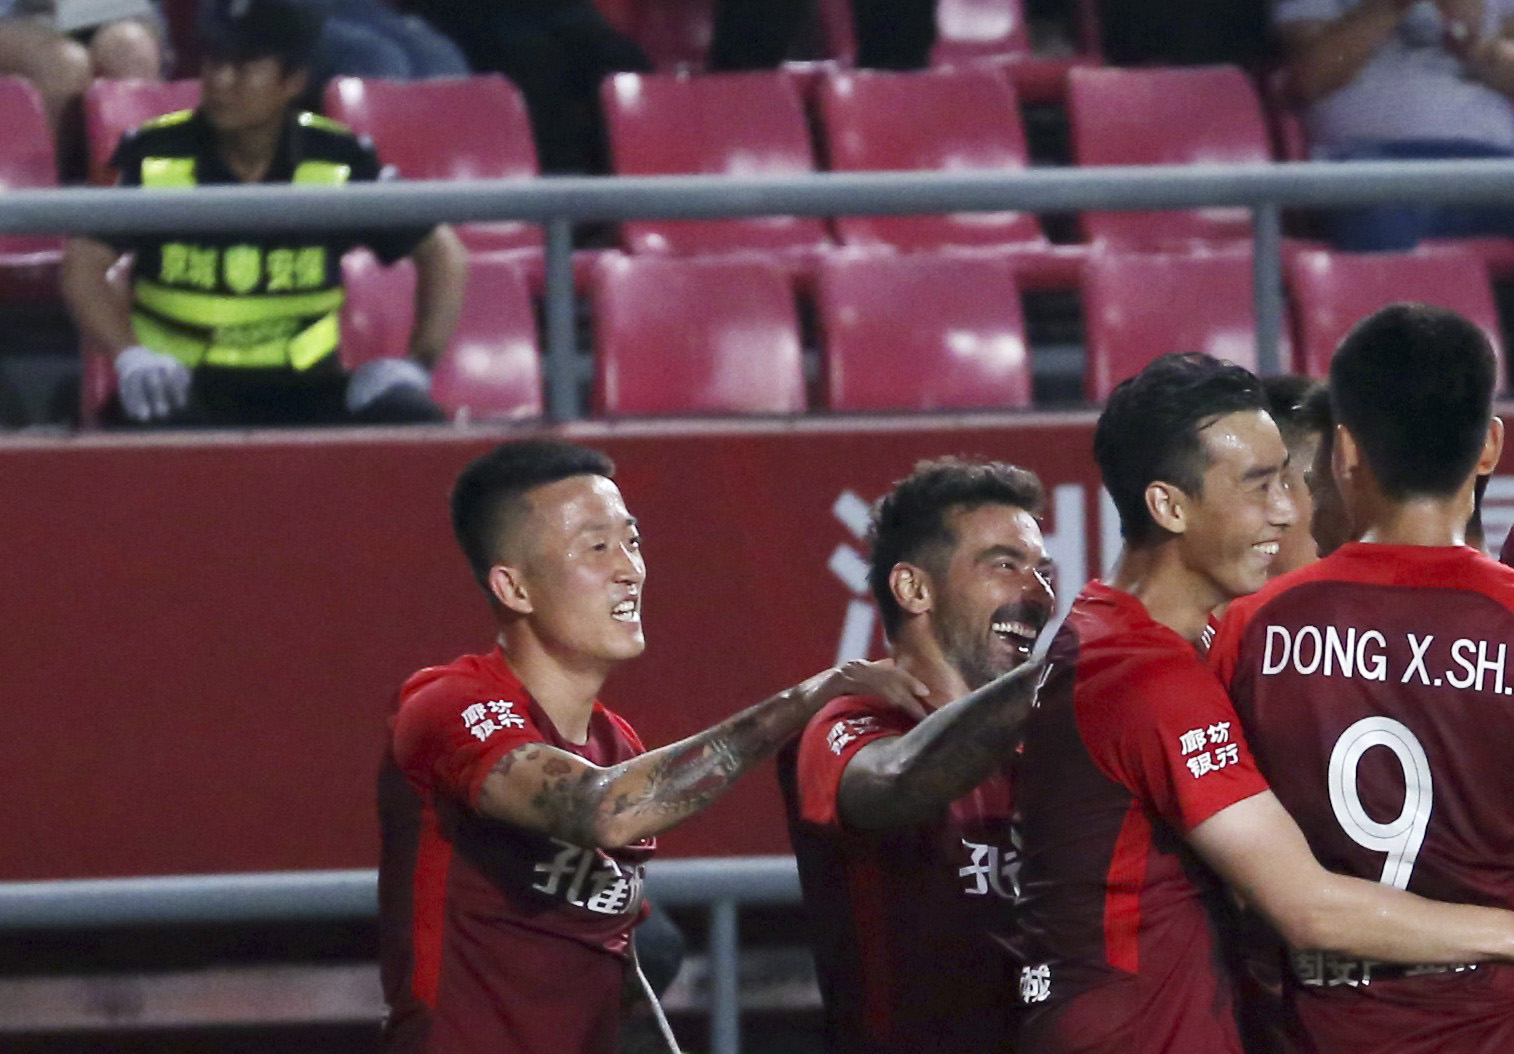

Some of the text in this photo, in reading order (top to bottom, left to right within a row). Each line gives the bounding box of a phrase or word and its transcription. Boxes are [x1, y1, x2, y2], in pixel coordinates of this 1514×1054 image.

[1262, 625, 1387, 681] DONG
[1401, 634, 1513, 695] X.SH.
[1179, 721, 1231, 756] 廊坊
[1186, 743, 1239, 779] 银行
[1328, 716, 1433, 891] 9
